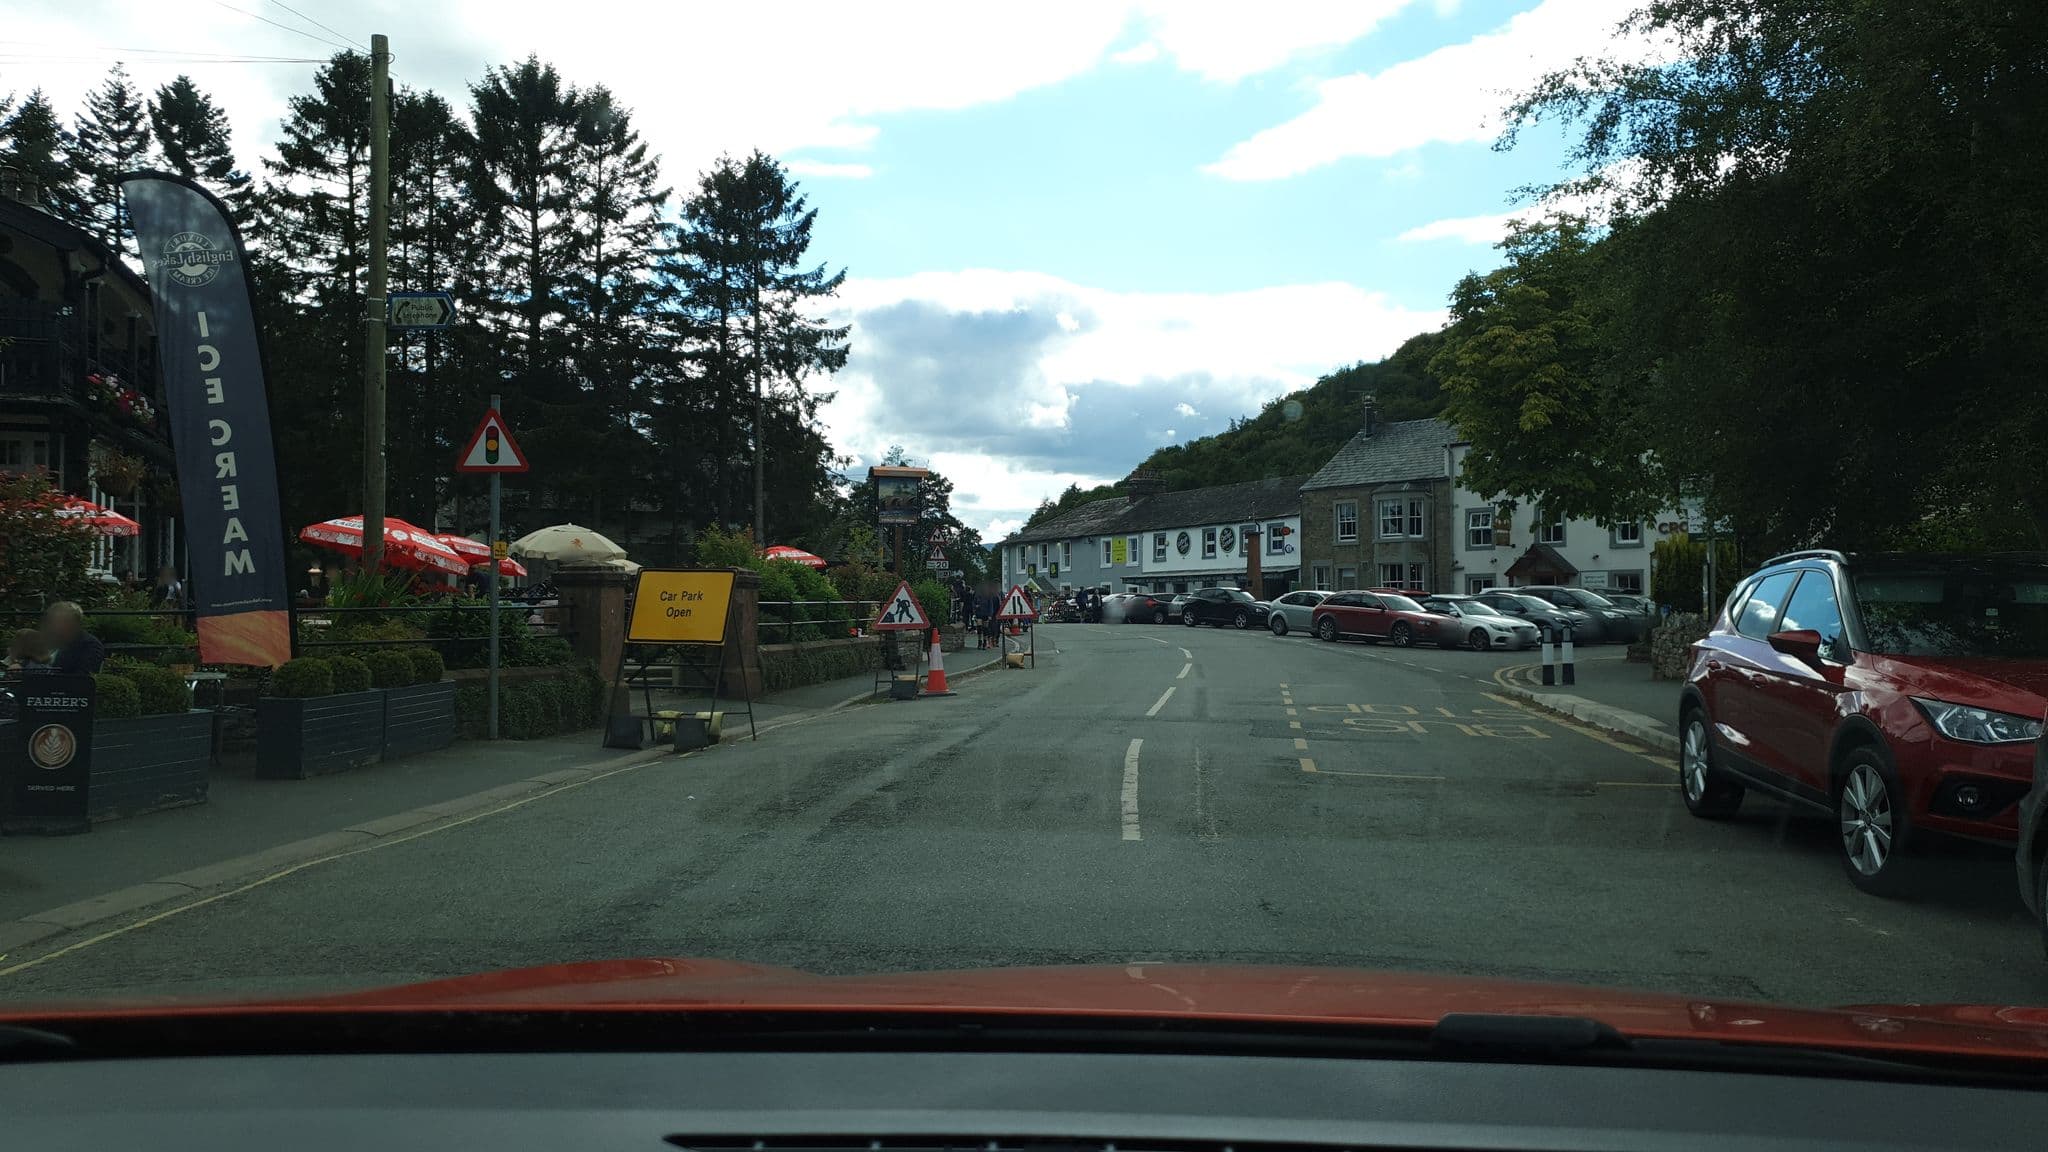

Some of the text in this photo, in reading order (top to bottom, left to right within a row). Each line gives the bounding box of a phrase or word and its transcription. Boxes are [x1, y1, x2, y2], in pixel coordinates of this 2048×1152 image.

[660, 590, 704, 601] Car Park
[666, 606, 692, 619] Open
[26, 696, 89, 708] FARRER'S
